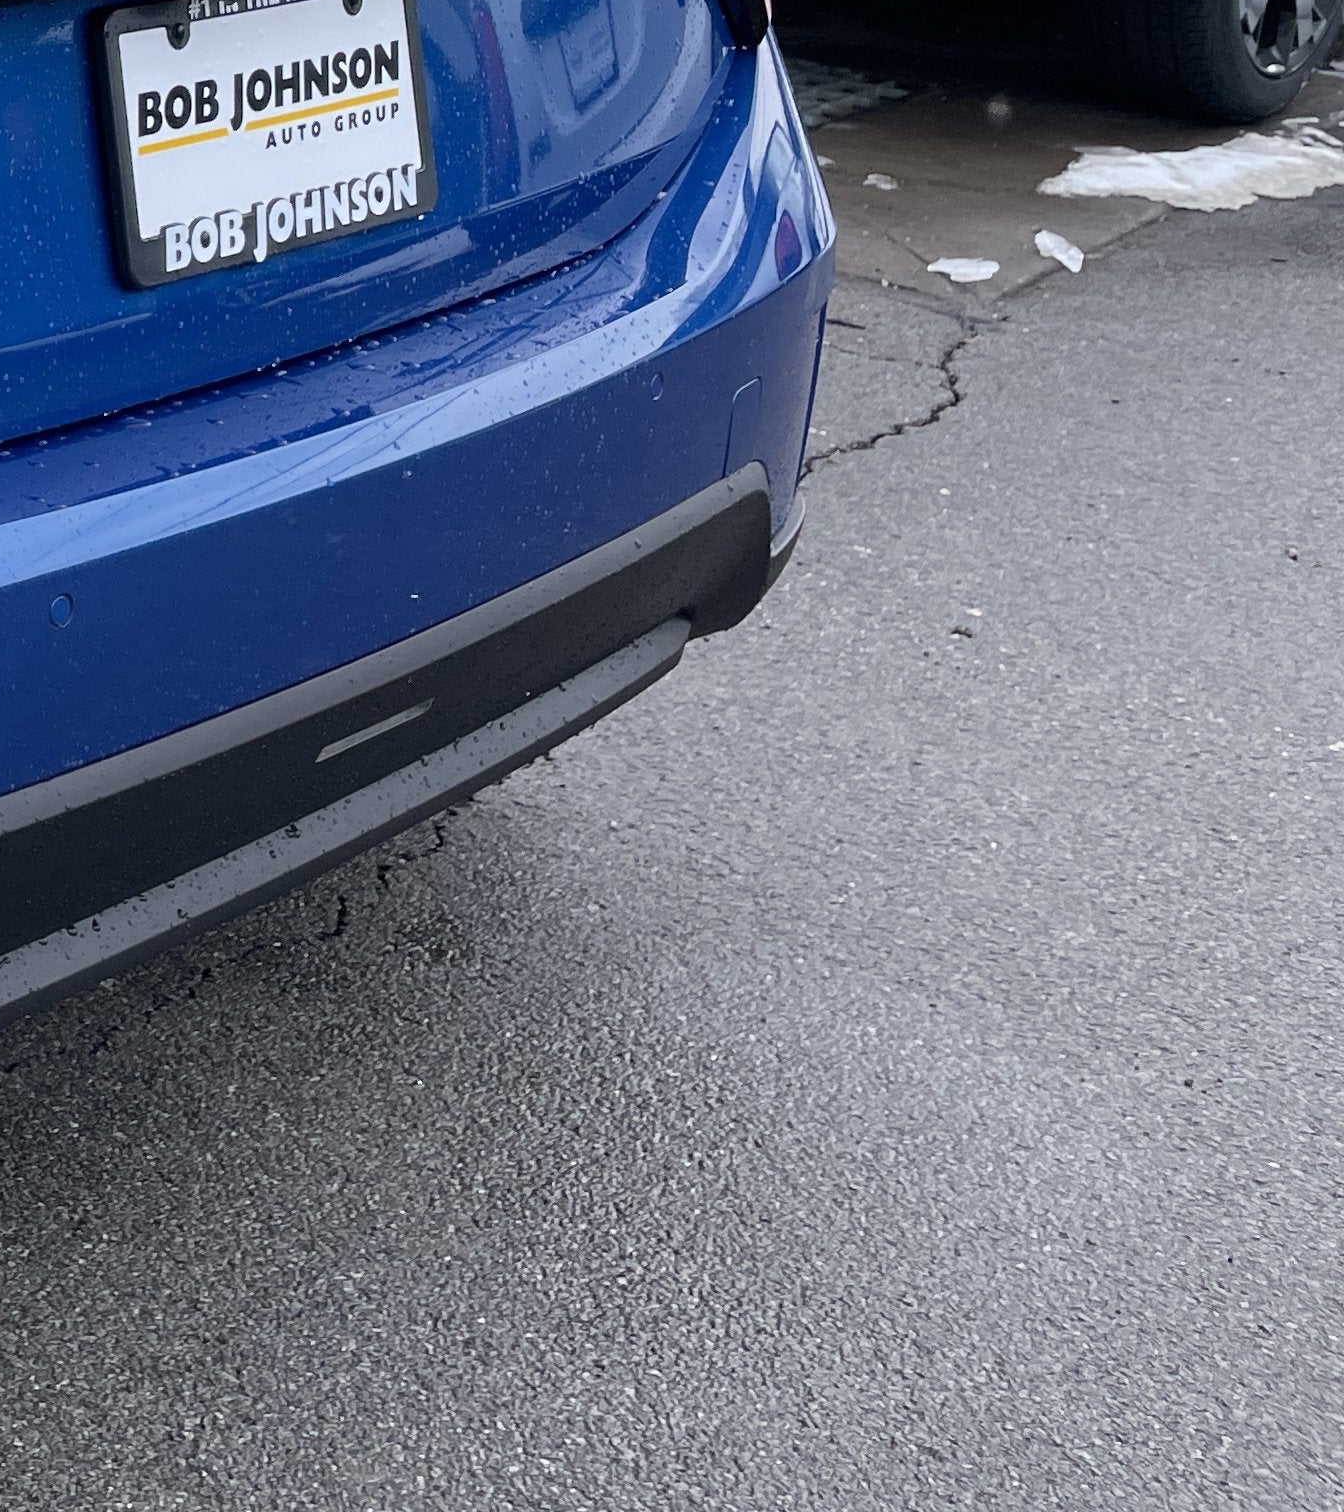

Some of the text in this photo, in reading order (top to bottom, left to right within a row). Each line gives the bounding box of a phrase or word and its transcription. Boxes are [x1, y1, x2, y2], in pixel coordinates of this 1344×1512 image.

[138, 40, 399, 137] BOB JOHNSON
[266, 102, 399, 149] AUTO GROUP
[165, 164, 418, 272] BOB JOHNSON
